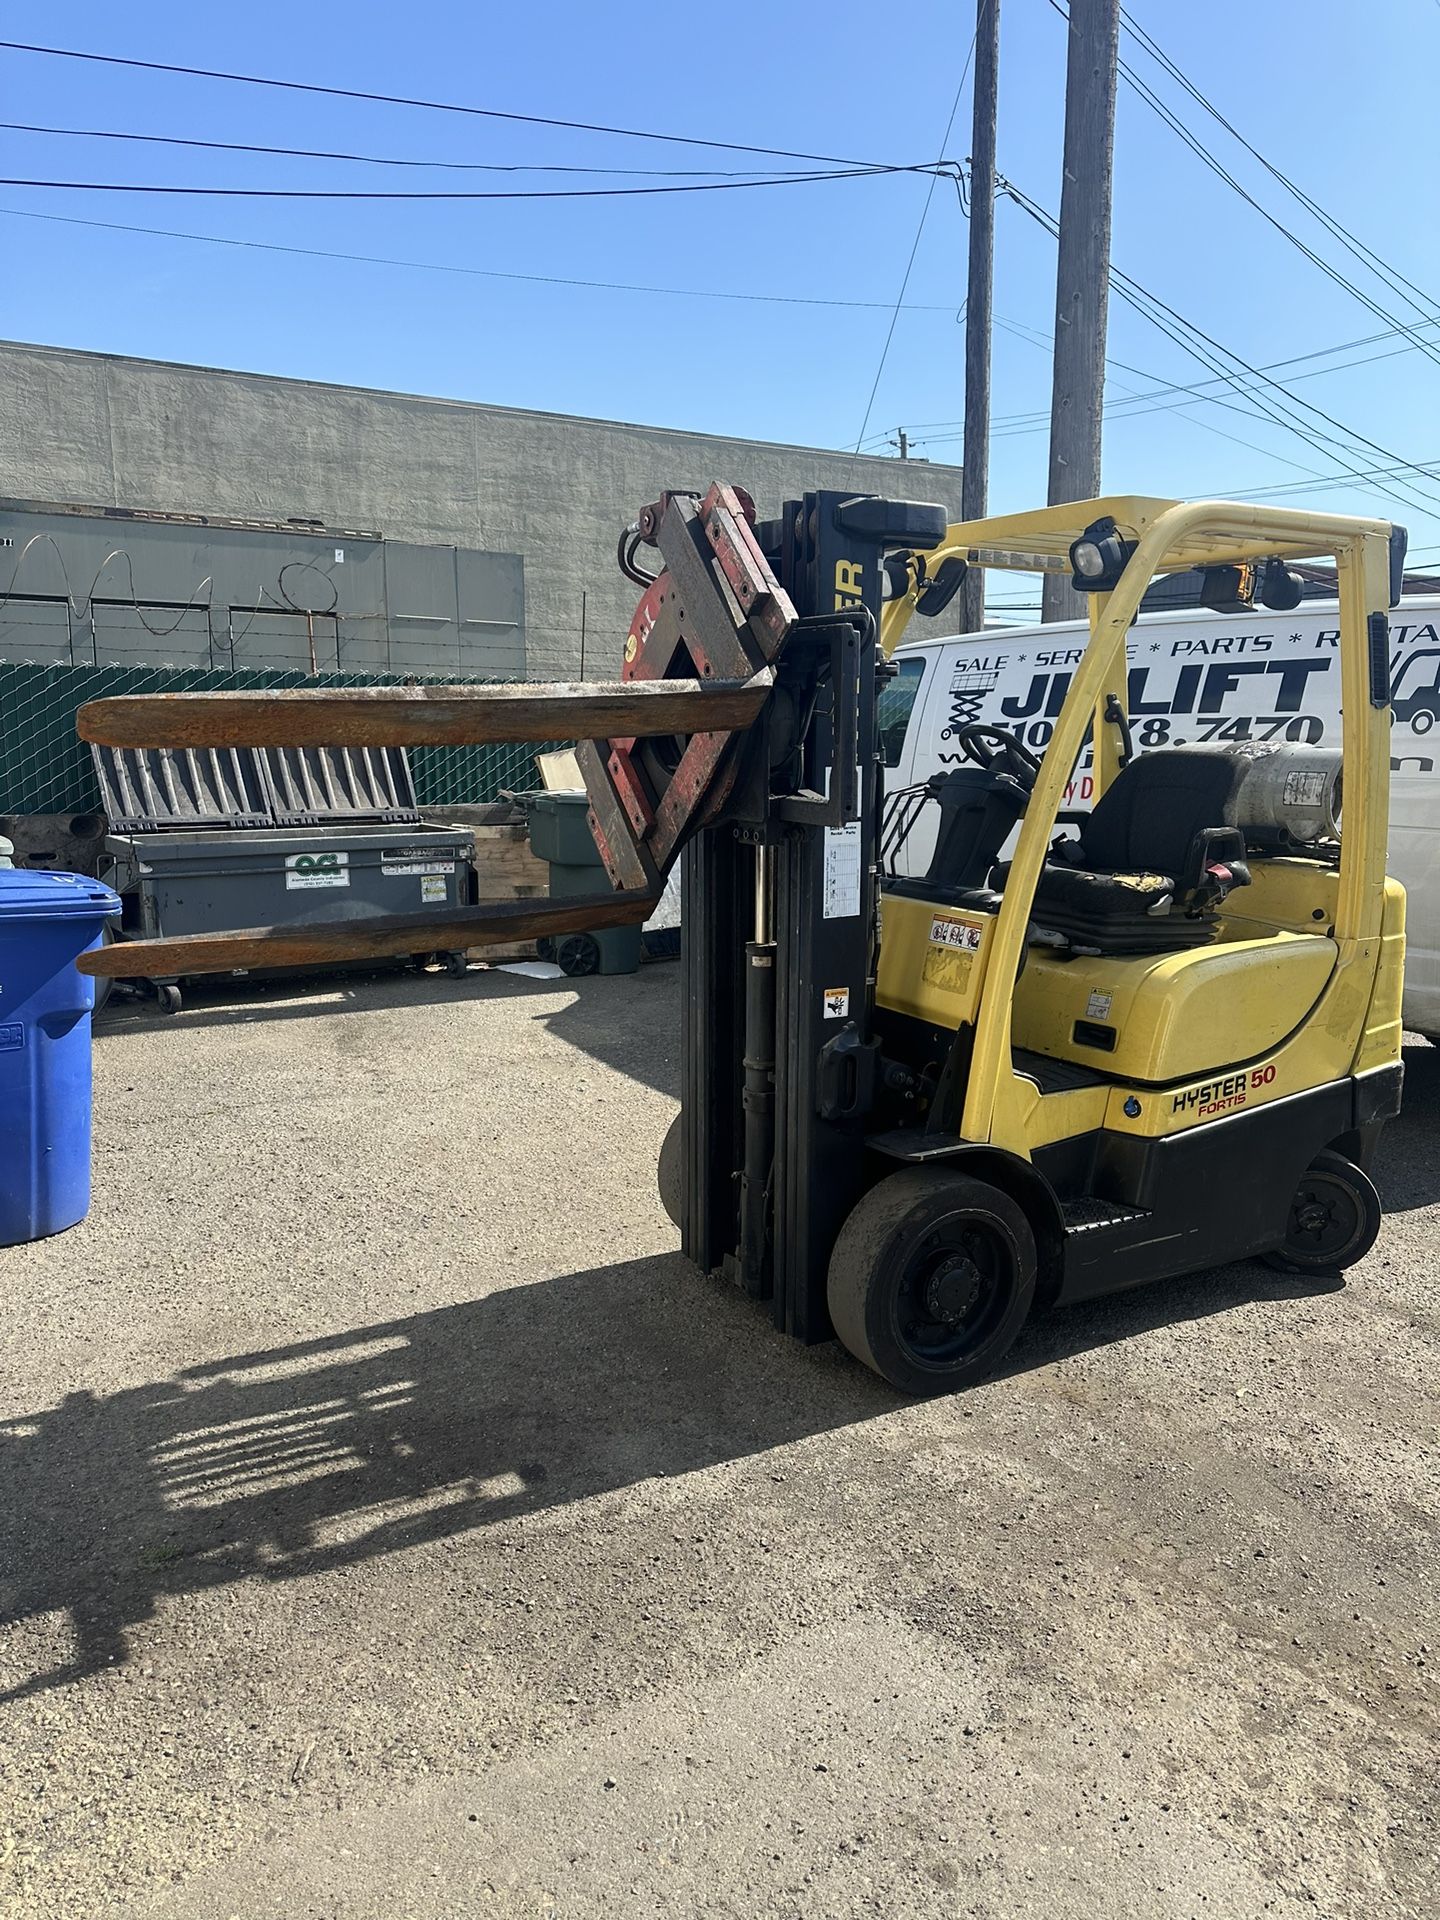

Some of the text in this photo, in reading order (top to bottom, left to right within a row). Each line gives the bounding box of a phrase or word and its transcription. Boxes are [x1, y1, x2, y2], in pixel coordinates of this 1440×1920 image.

[953, 655, 1010, 673] SALE
[1034, 643, 1139, 667] SERE
[1170, 634, 1274, 657] PARTS
[1172, 1065, 1276, 1113] HYSTER 50
[1198, 1093, 1246, 1117] FORTIS
